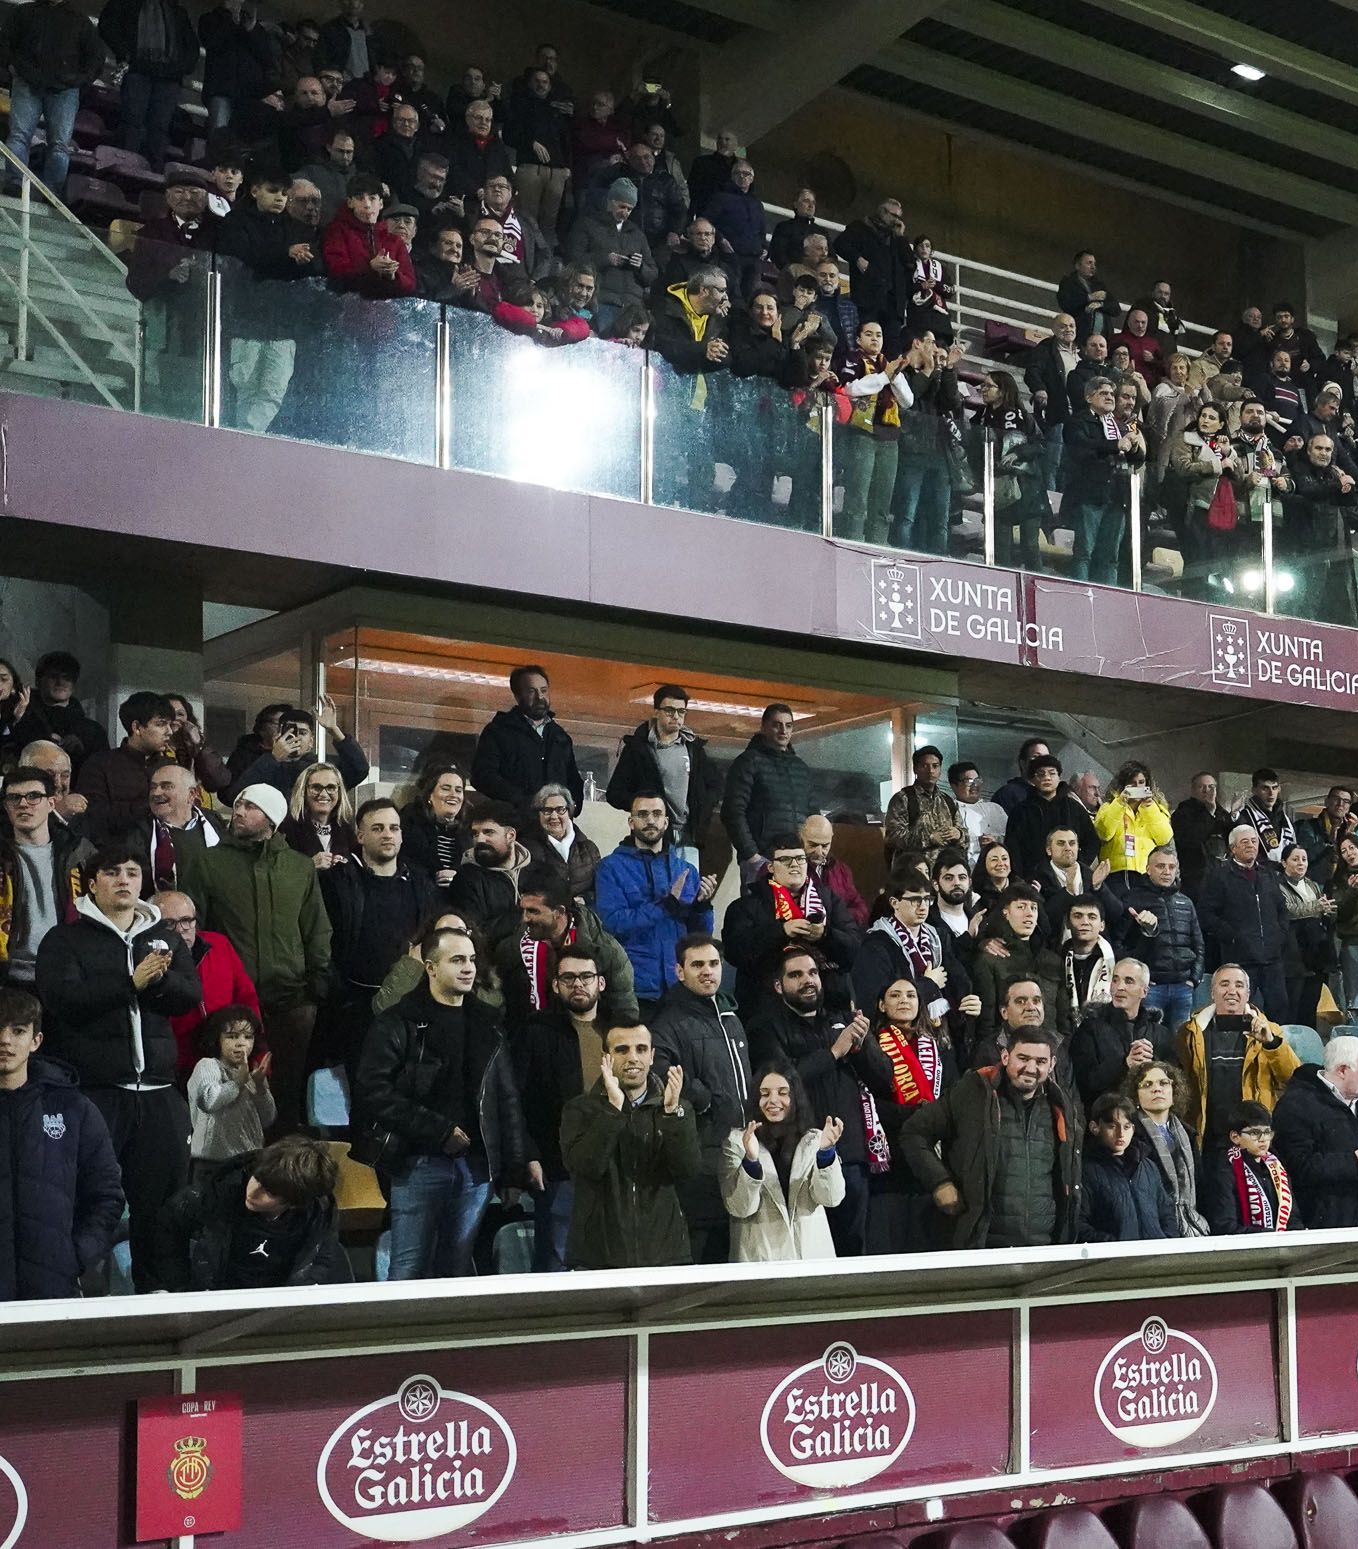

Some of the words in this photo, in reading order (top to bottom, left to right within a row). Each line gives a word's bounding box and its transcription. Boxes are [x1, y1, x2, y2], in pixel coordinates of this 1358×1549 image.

[929, 577, 1012, 613] XUNTA
[929, 608, 961, 635] DE
[966, 614, 1064, 651] GALICIA
[1257, 630, 1323, 662] XUNTA
[1257, 659, 1283, 684] DE
[879, 1032, 920, 1102] MALLORCA
[1112, 1352, 1202, 1390] Estrella
[182, 1401, 199, 1414] COPA
[203, 1400, 216, 1412] REY
[783, 1381, 897, 1424] Estrella
[1117, 1384, 1200, 1422] Galicia
[347, 1420, 493, 1469] Estrella
[789, 1417, 891, 1460] Galicia
[354, 1459, 486, 1510] Galicia
